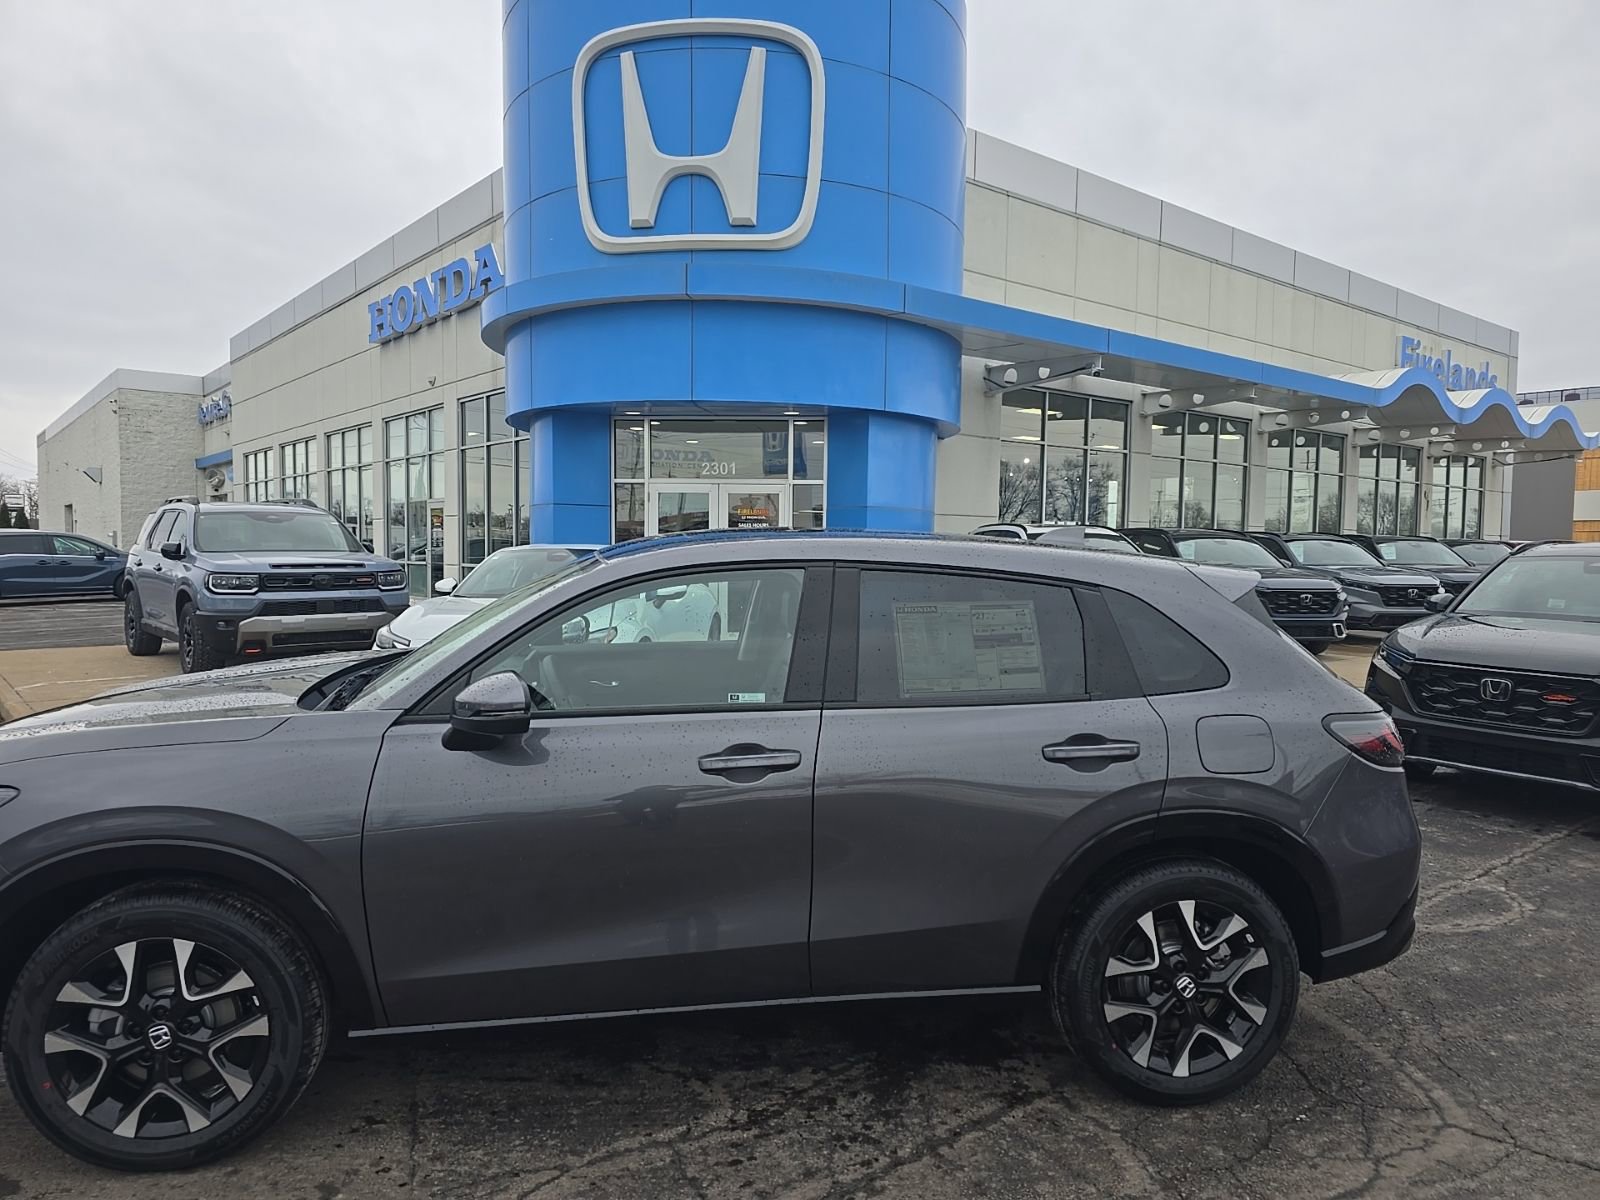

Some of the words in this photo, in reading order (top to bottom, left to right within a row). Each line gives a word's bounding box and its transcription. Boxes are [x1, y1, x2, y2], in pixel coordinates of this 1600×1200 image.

[368, 242, 504, 343] HONDA
[702, 462, 736, 475] 2301
[903, 605, 937, 614] HONDA
